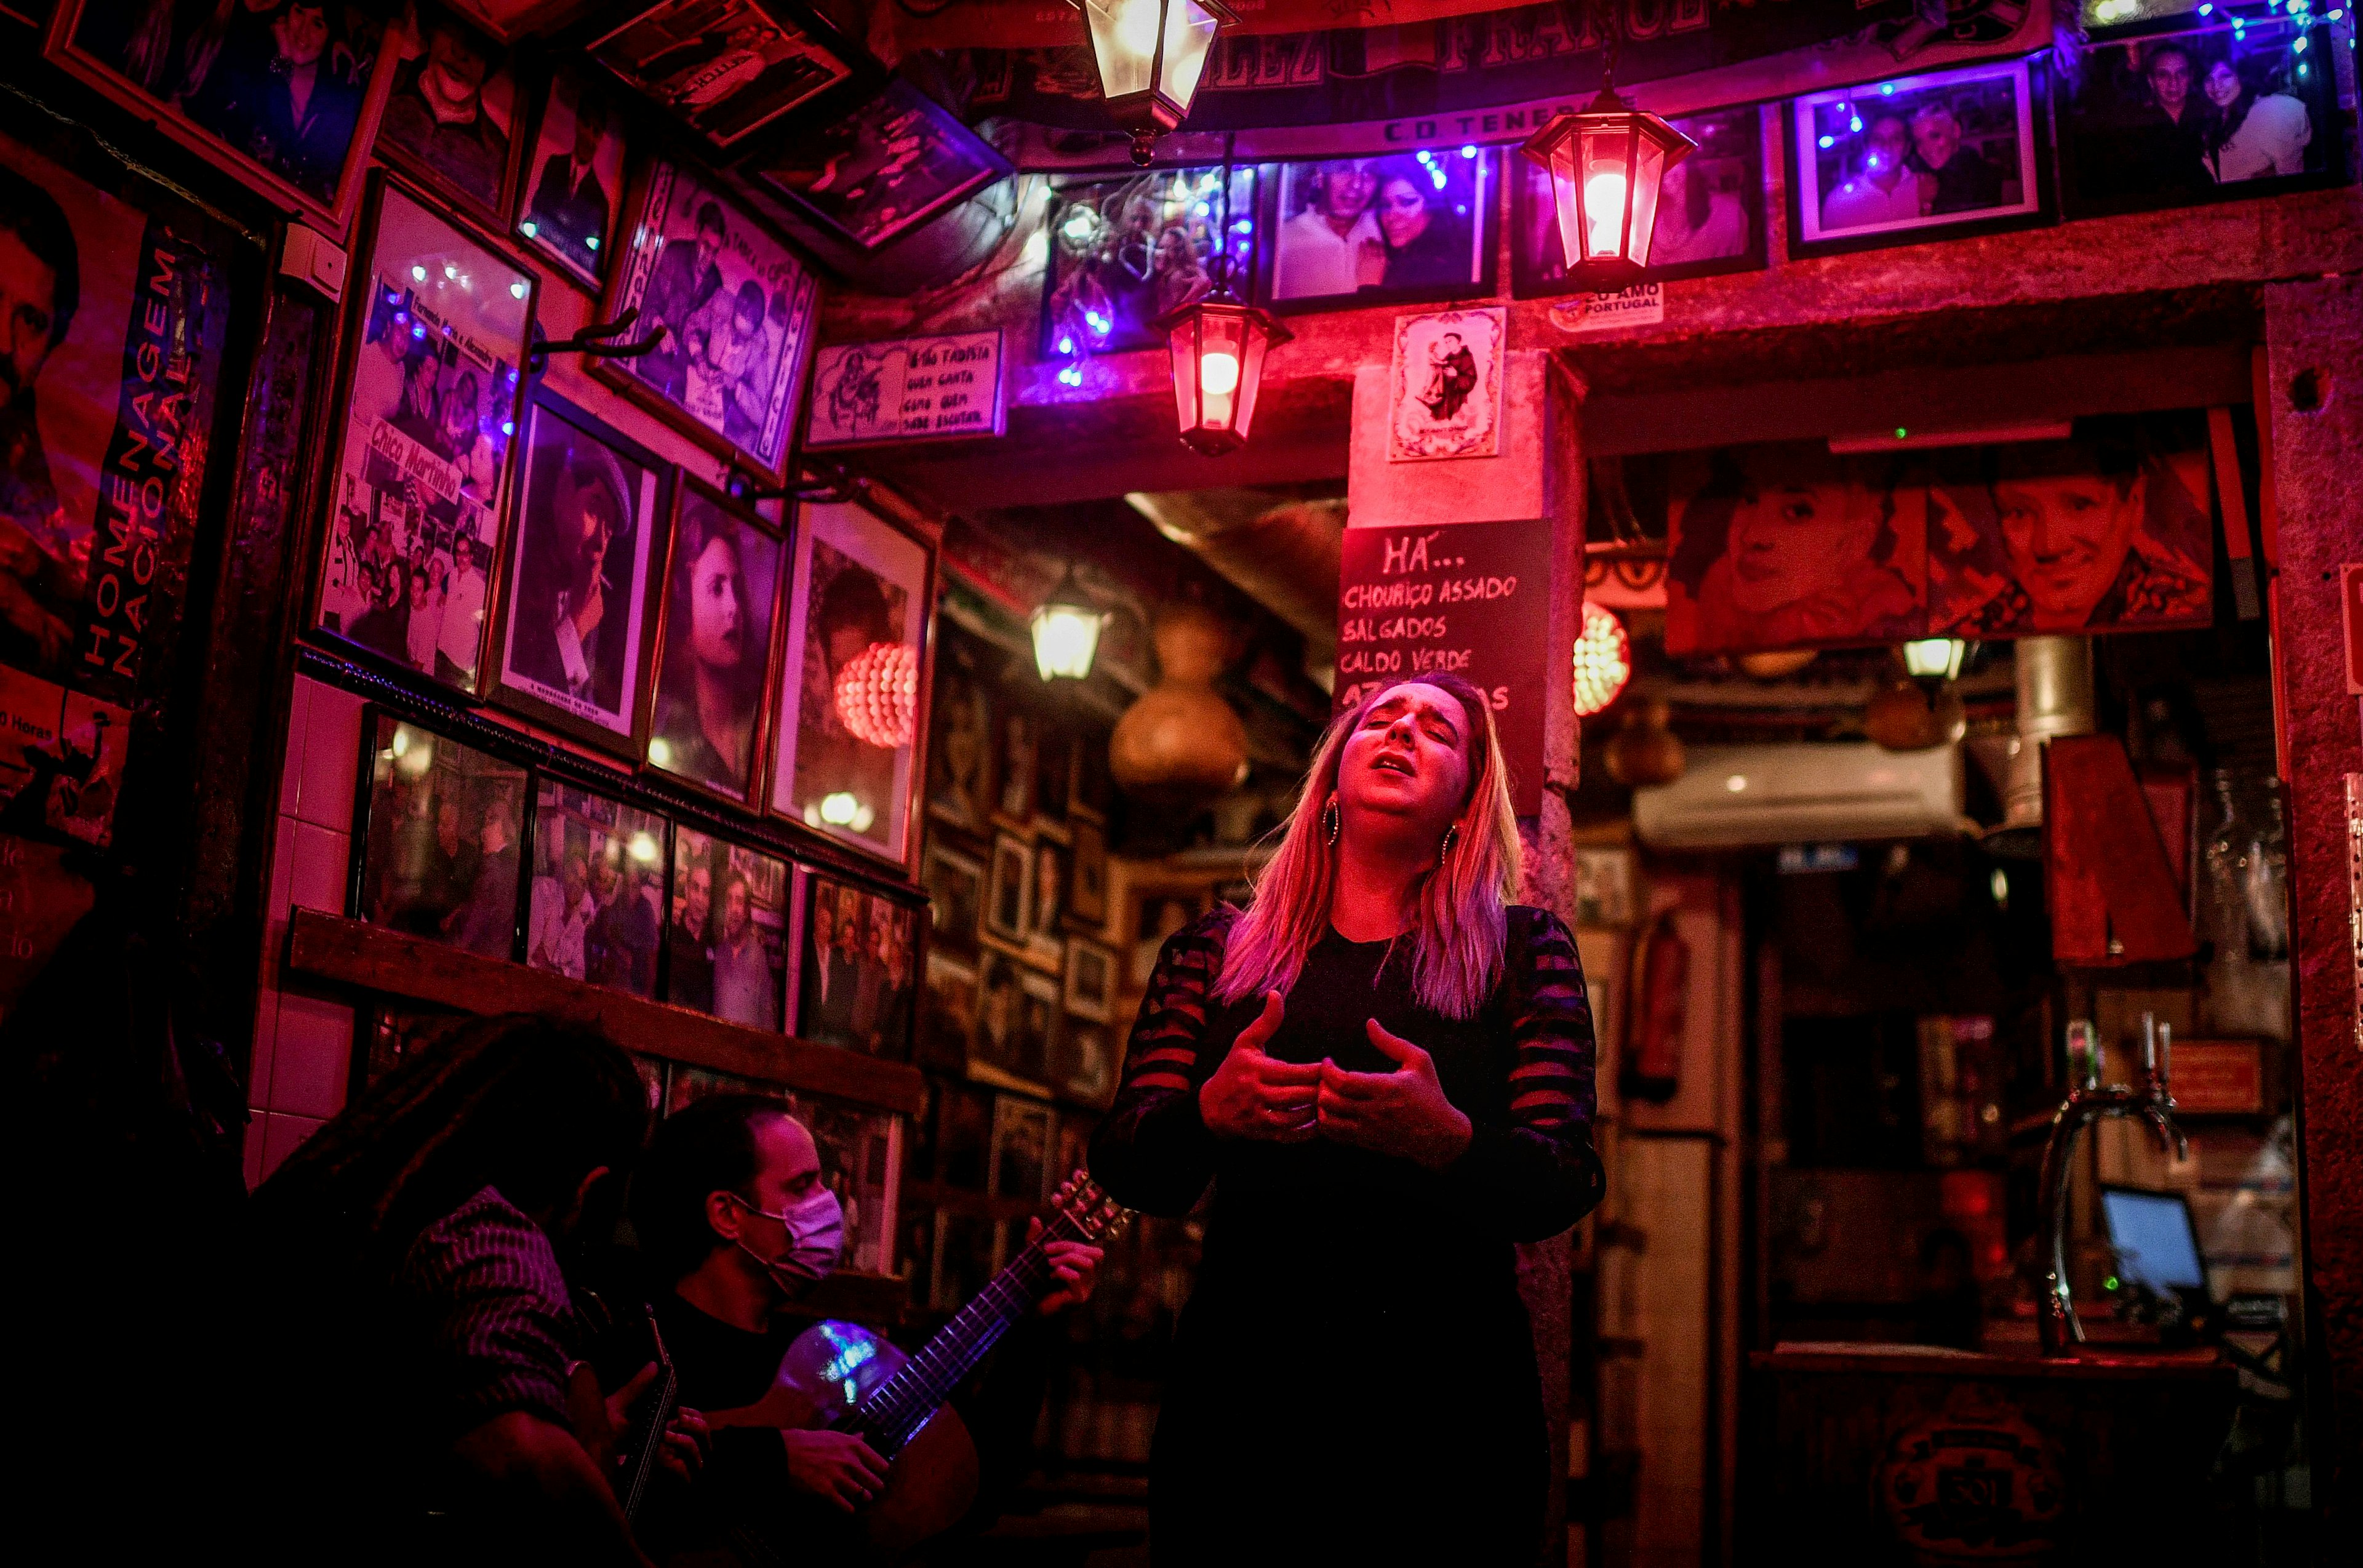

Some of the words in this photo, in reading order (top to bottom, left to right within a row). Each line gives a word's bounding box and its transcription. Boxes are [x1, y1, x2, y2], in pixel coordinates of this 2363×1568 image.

[1617, 282, 1659, 299] AMO
[1585, 298, 1660, 313] PORTUGAL
[938, 370, 974, 386] CANTA
[936, 410, 983, 429] ESCUTAR
[84, 247, 176, 666] HOMENAGEM
[372, 421, 404, 463] Chico
[404, 442, 456, 499] Martinho
[112, 353, 191, 678] NACIONAL
[1343, 582, 1433, 609] CHOURIÇO
[1438, 575, 1517, 604] ASSADO
[1341, 616, 1447, 642] SALGADOS
[1340, 649, 1401, 674] CALDO
[1412, 646, 1473, 671] VERDE
[12, 714, 52, 738] Horas
